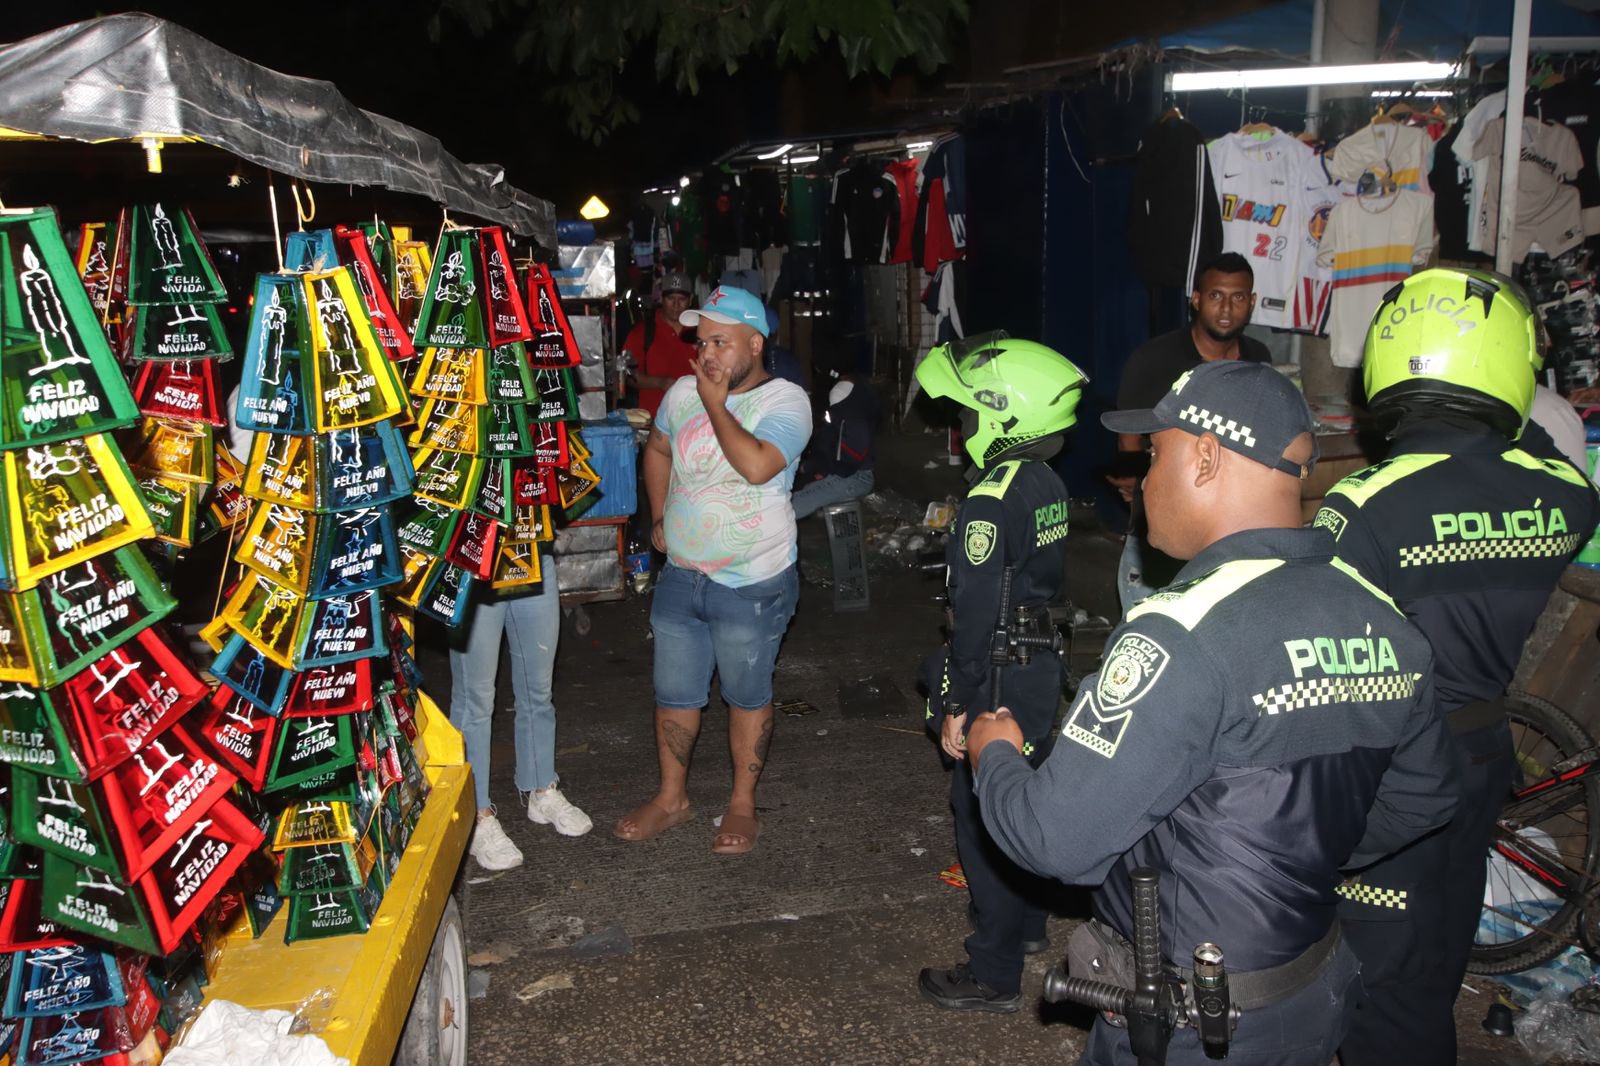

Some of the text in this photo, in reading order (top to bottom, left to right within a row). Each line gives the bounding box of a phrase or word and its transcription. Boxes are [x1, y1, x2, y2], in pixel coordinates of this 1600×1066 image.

[1253, 233, 1288, 261] 22
[167, 276, 201, 284] FELIZ
[498, 314, 517, 324] FELIZ
[1380, 294, 1477, 340] POLICÍA
[436, 325, 463, 334] FELIZ
[495, 323, 522, 333] NAVIDAD
[158, 342, 206, 354] NAVIDAD
[164, 334, 198, 344] FELIZ
[430, 334, 466, 344] NAVIDAD
[535, 350, 564, 358] NAVIDAD
[425, 383, 462, 392] NAVIDAD
[431, 374, 458, 383] FELIZ
[501, 379, 520, 388] FELIZ
[28, 380, 86, 402] FELIZ
[163, 387, 199, 402] FELIZ
[324, 374, 376, 403] FELIZ AÑO
[21, 395, 99, 423] NAVIDAD
[243, 397, 287, 413] FELIZ AÑO
[339, 392, 371, 410] NUEVO
[541, 401, 561, 409] FELIZ
[252, 412, 278, 424] NUEVO
[427, 421, 450, 434] FELIZ
[489, 431, 518, 442] FELIZ AÑO
[495, 443, 514, 451] NUEVO
[257, 463, 303, 490] FELIZ AÑO
[334, 465, 386, 488] FELIZ AÑO
[265, 478, 292, 498] NUEVO
[346, 482, 378, 498] NUEVO
[524, 482, 543, 492] FELIZ
[481, 487, 506, 508] FELIZ AÑO
[57, 494, 109, 529] FELIZ
[1431, 497, 1568, 542] POLICÍA
[54, 504, 124, 552] NAVIDAD
[397, 527, 434, 547] NAVIDAD
[405, 521, 435, 538] FELIZ
[251, 535, 293, 563] FELIZ AÑO
[466, 539, 483, 555] FELIZ
[253, 551, 282, 572] NUEVO
[330, 544, 383, 570] FELIZ AÑO
[341, 559, 374, 578] NUEVO
[508, 566, 528, 574] FELIZ
[58, 580, 136, 628] FELIZ AÑO
[439, 594, 455, 608] FELIZ
[80, 604, 129, 637] NUEVO
[314, 627, 367, 639] FELIZ AÑO
[323, 640, 356, 651] NUEVO
[1122, 638, 1158, 662] POLICÍA
[1284, 622, 1400, 678] POLICÍA
[1112, 647, 1154, 677] NACIONAL
[304, 672, 357, 690] FELIZ AÑO
[312, 688, 345, 700] NUEVO
[122, 681, 165, 729] FELIZ
[126, 687, 179, 753] NAVIDAD
[3, 730, 45, 747] FELIZ
[223, 723, 252, 746] FELIZ
[296, 729, 330, 750] FELIZ
[291, 737, 336, 761] NAVIDAD
[165, 759, 206, 807] FELIZ
[164, 762, 219, 824] NAVIDAD
[44, 813, 87, 841] FELIZ
[290, 818, 320, 830] FELIZ
[37, 822, 96, 856] NAVIDAD
[175, 839, 216, 889] FELIZ
[174, 842, 228, 907] NAVIDAD
[65, 894, 108, 918] FELIZ
[318, 909, 348, 919] FELIZ
[58, 902, 119, 933] NAVIDAD
[312, 916, 353, 928] NAVIDAD
[24, 975, 91, 1002] FELIZ AÑO
[73, 1028, 100, 1042] AÑO
